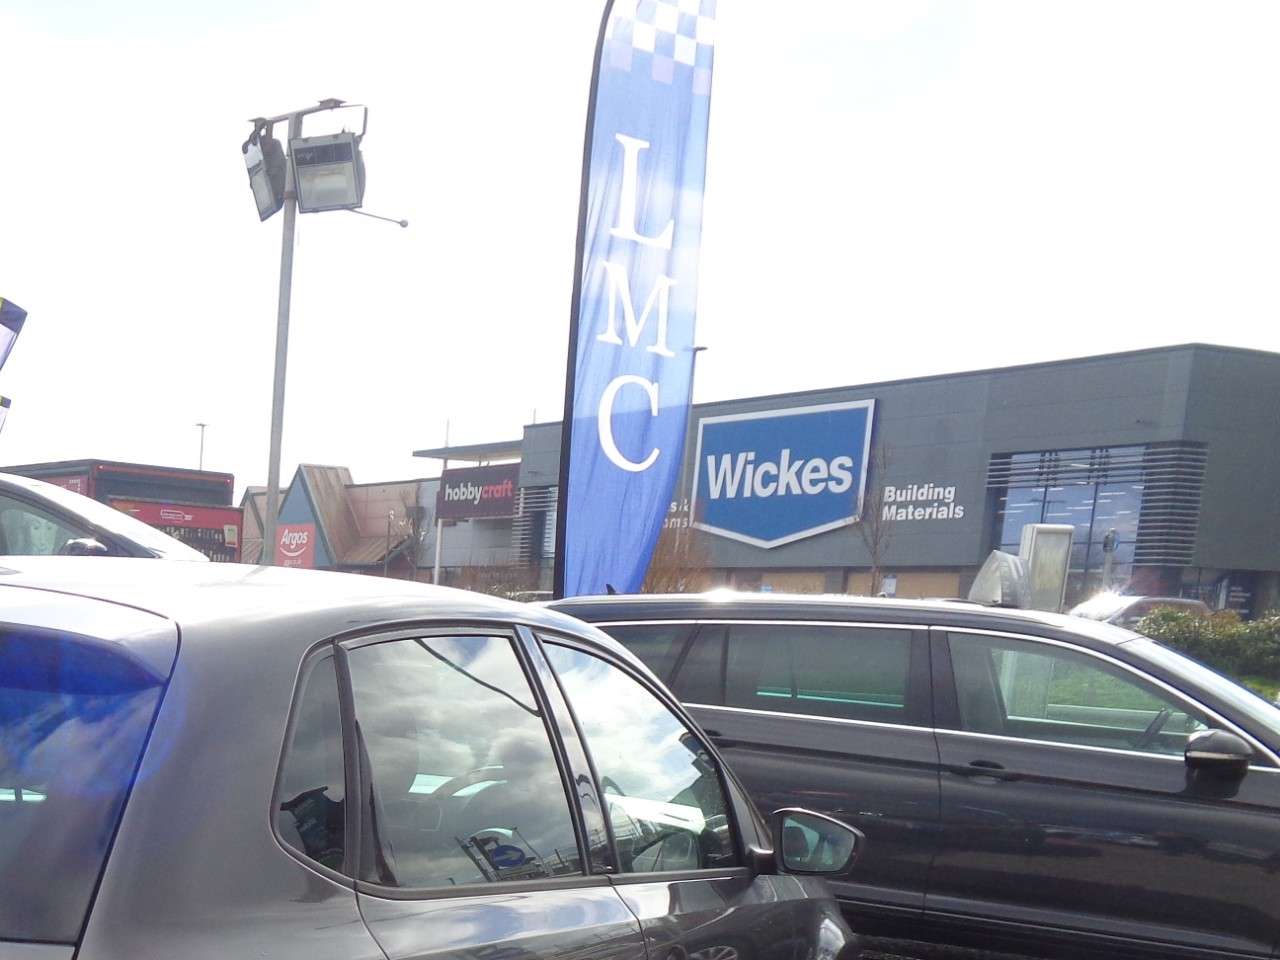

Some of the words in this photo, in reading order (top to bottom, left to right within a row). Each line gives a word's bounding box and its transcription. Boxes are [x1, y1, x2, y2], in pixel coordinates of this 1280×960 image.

[596, 132, 677, 473] LMC
[706, 448, 853, 500] Wickes
[444, 479, 513, 505] hobbycraft
[883, 483, 956, 503] Building
[881, 502, 965, 521] Materials
[280, 528, 309, 549] Argos
